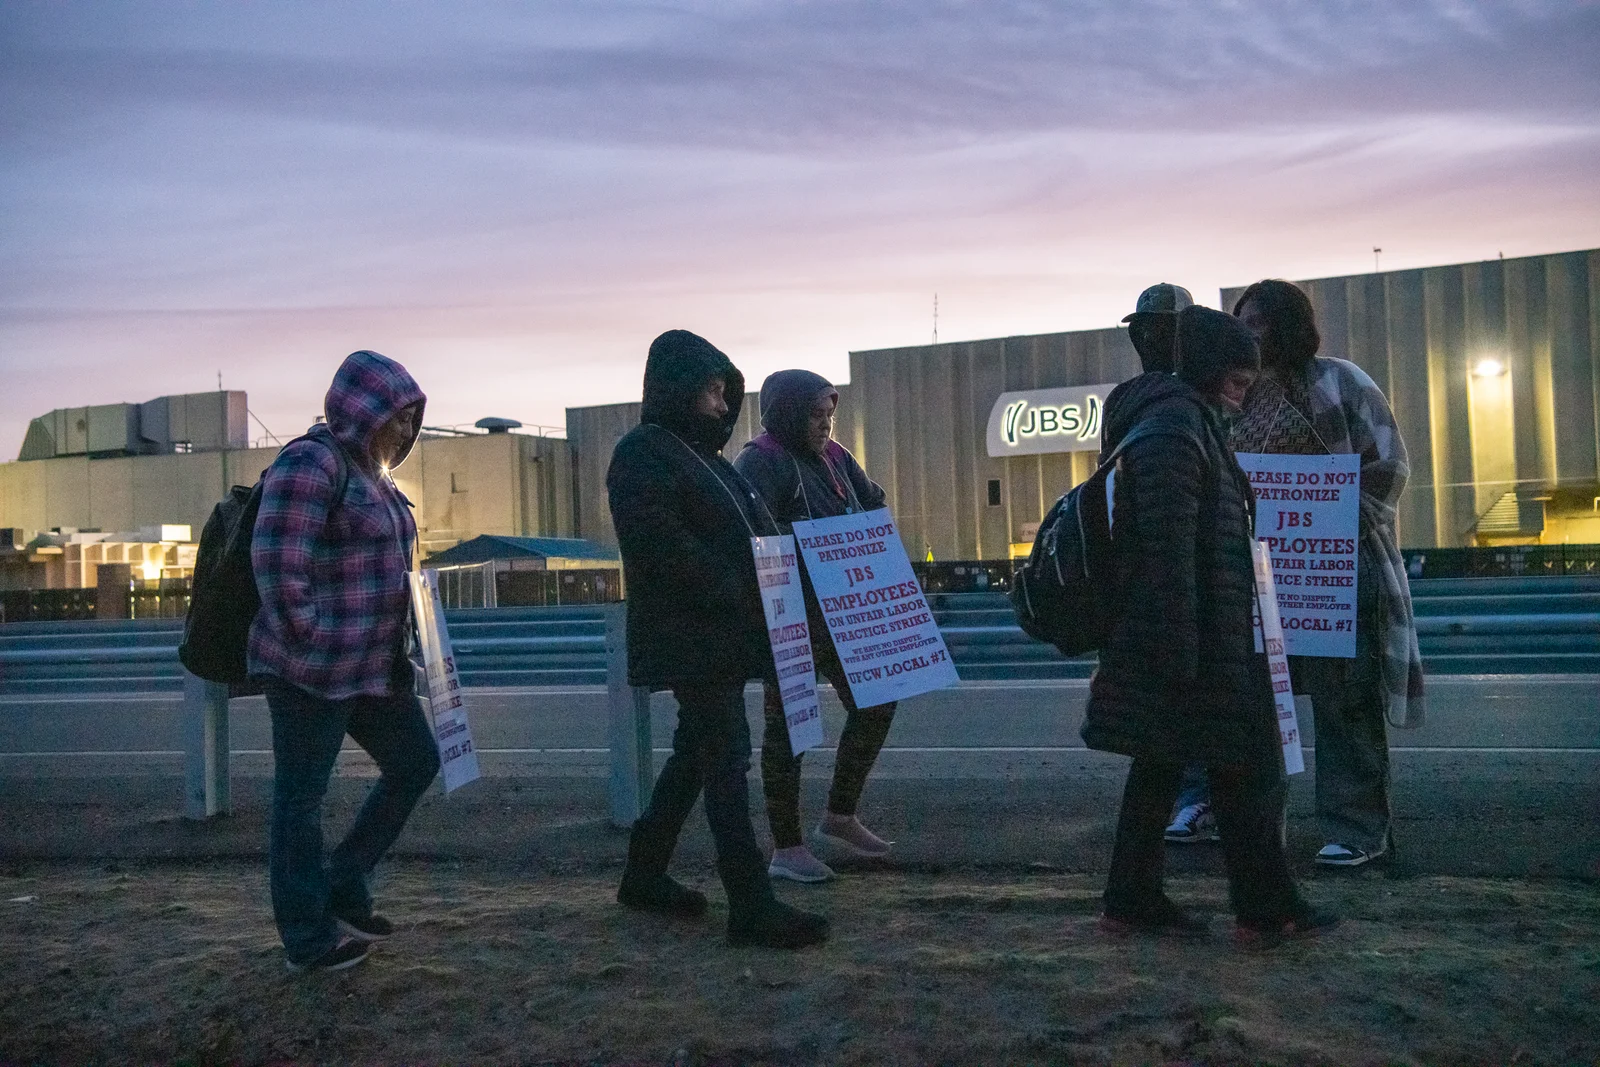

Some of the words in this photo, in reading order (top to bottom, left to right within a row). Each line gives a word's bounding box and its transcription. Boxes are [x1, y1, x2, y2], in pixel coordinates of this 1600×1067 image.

[1021, 407, 1080, 434] JBS
[1296, 473, 1319, 485] DO
[1323, 472, 1357, 485] NOT
[1276, 511, 1313, 531] JBS
[801, 532, 844, 549] PLEASE
[845, 529, 864, 543] DO
[866, 523, 895, 540] NOT
[1258, 537, 1355, 554] PLOYEES
[818, 541, 887, 562] PATRONIZE
[1309, 559, 1355, 571] LABOR
[844, 565, 875, 587] JBS
[1305, 576, 1354, 587] STRIKE
[822, 580, 920, 613] EMPLOYEES
[1301, 594, 1336, 602] DISPUTE
[1305, 602, 1352, 610] EMPLOYER
[829, 615, 845, 629] ON
[845, 608, 887, 625] UNFAIR
[886, 599, 926, 617] LABOR
[1280, 617, 1332, 632] LOCAL
[1335, 619, 1353, 632] #7
[834, 623, 889, 643] PRACTICE
[889, 612, 932, 633] STRIKE
[852, 647, 864, 655] WE
[864, 644, 882, 653] HAVE
[882, 641, 892, 649] NO
[893, 634, 922, 648] DISPUTE
[861, 652, 875, 662] ANY
[876, 647, 898, 658] OTHER
[898, 636, 938, 653] EMPLOYER
[848, 667, 883, 684] UFCW
[884, 656, 930, 677] LOCAL
[931, 650, 947, 664] #7
